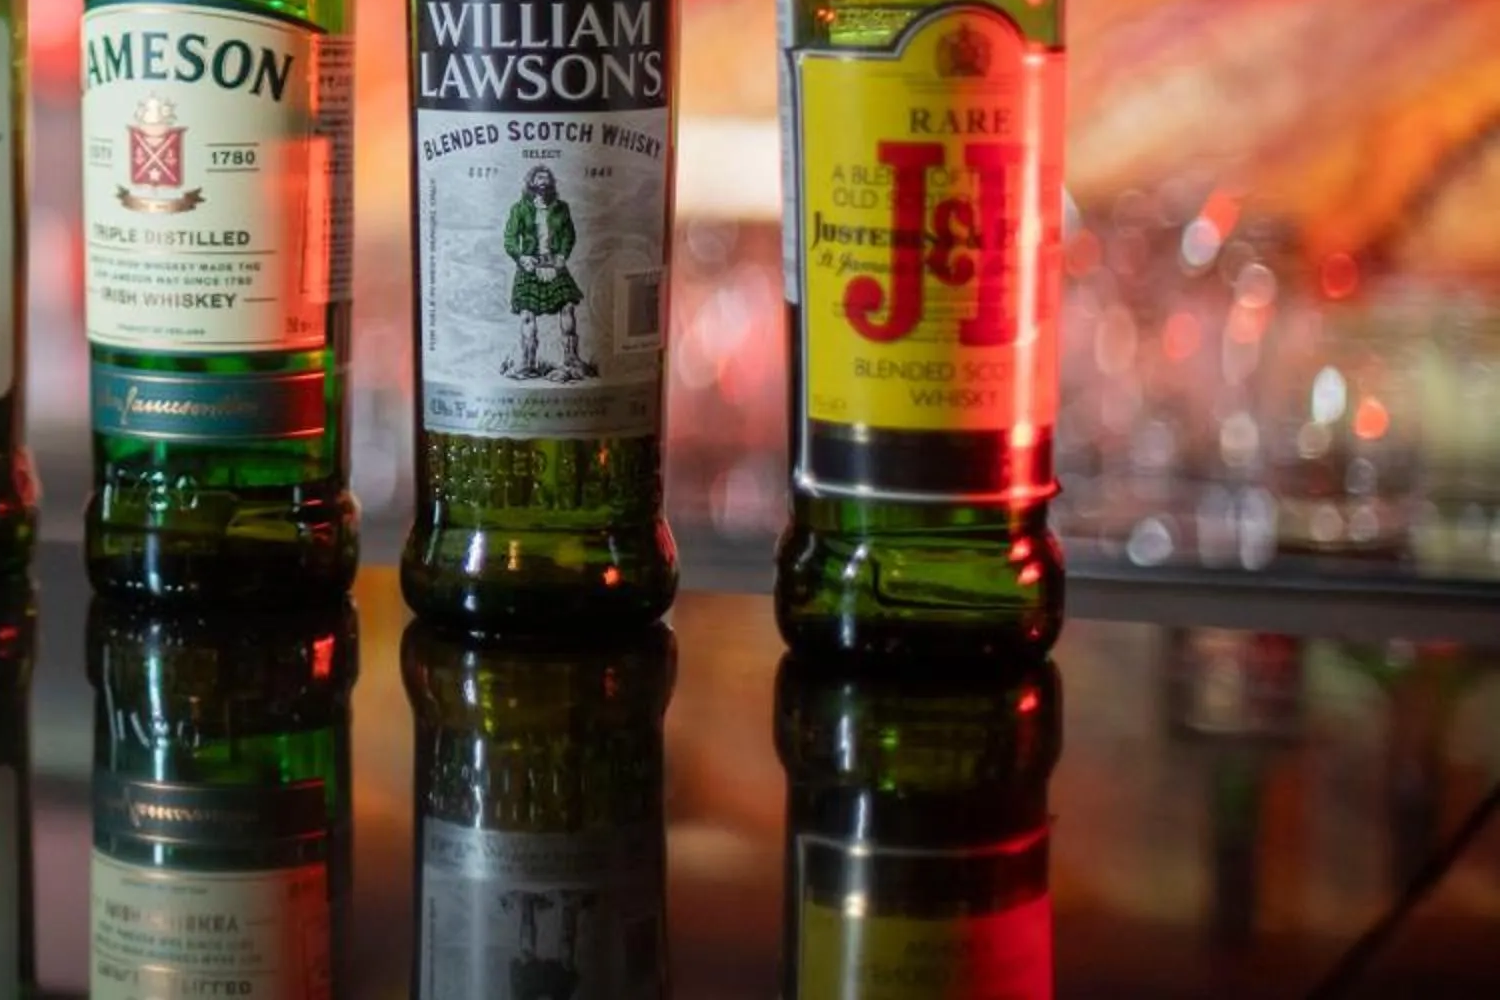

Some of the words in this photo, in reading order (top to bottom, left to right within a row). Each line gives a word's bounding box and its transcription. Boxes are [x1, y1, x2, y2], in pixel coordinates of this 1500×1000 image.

[427, 1, 653, 49] WILLIAM
[87, 31, 295, 102] AMESON
[420, 50, 662, 100] LAWSON'S
[908, 106, 1012, 136] RARE
[423, 123, 499, 162] BLENDED
[506, 119, 594, 144] SCOTCH
[601, 122, 662, 160] WHISKY
[210, 151, 257, 165] 1780
[832, 186, 879, 210] OLD
[143, 228, 251, 247] DISTILLED
[143, 291, 238, 310] WHISKEY
